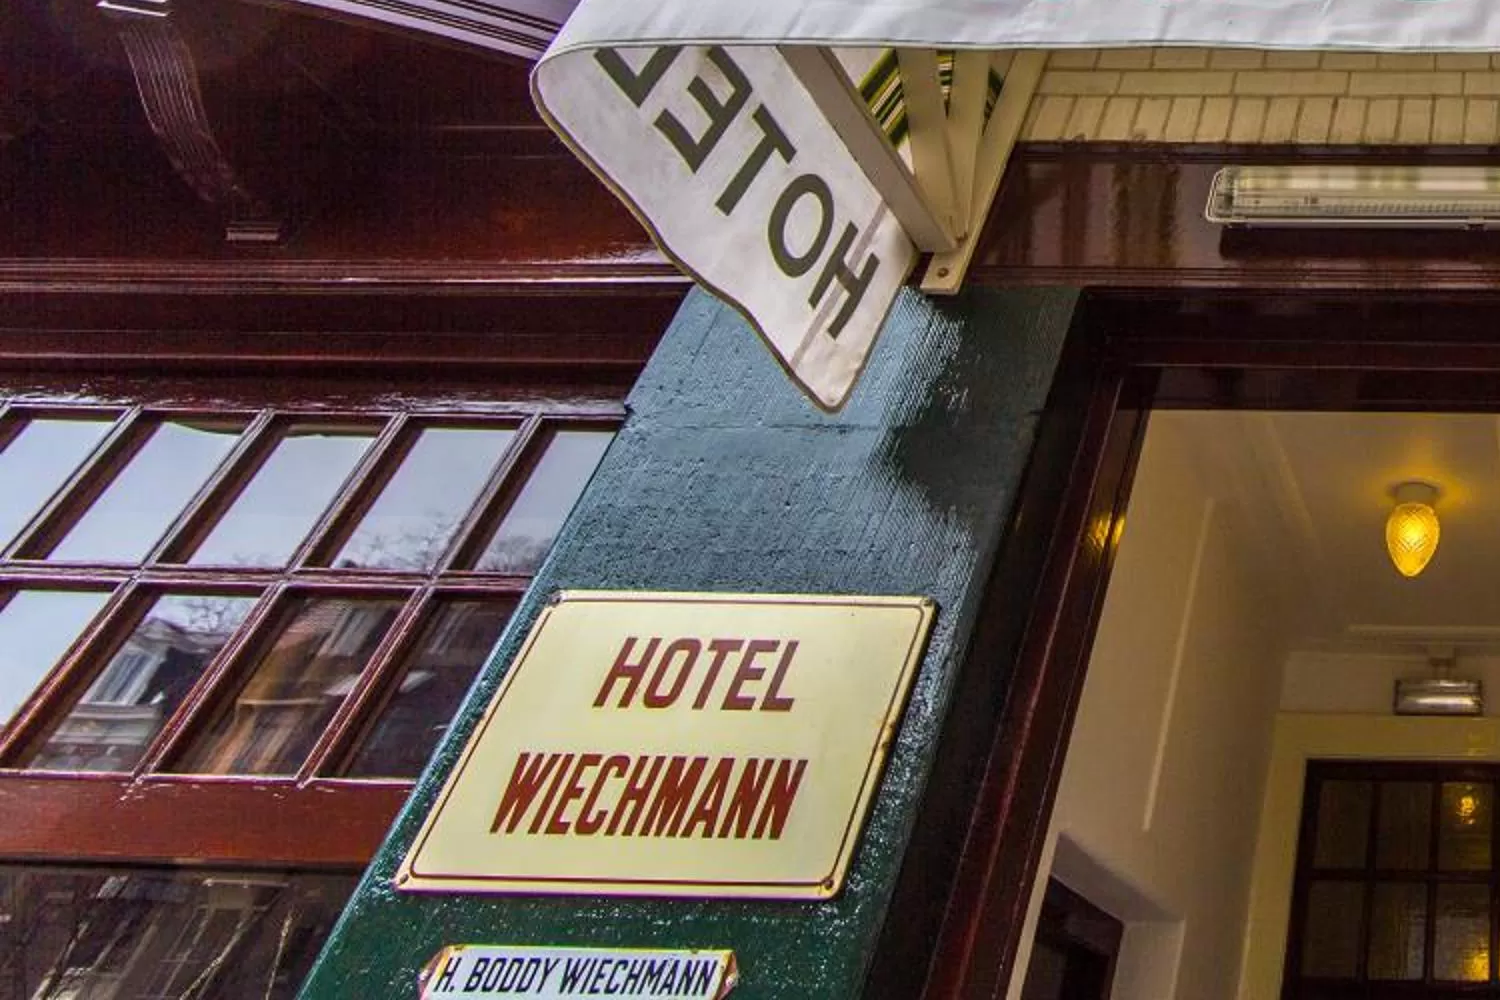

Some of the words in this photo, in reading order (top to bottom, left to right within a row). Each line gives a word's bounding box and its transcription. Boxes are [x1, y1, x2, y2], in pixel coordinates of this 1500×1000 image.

[593, 637, 800, 711] HOTEL
[490, 753, 807, 840] WIECHMANN
[434, 957, 462, 992] H.
[465, 957, 560, 993] BODDY
[558, 957, 718, 996] WIECHMANN
